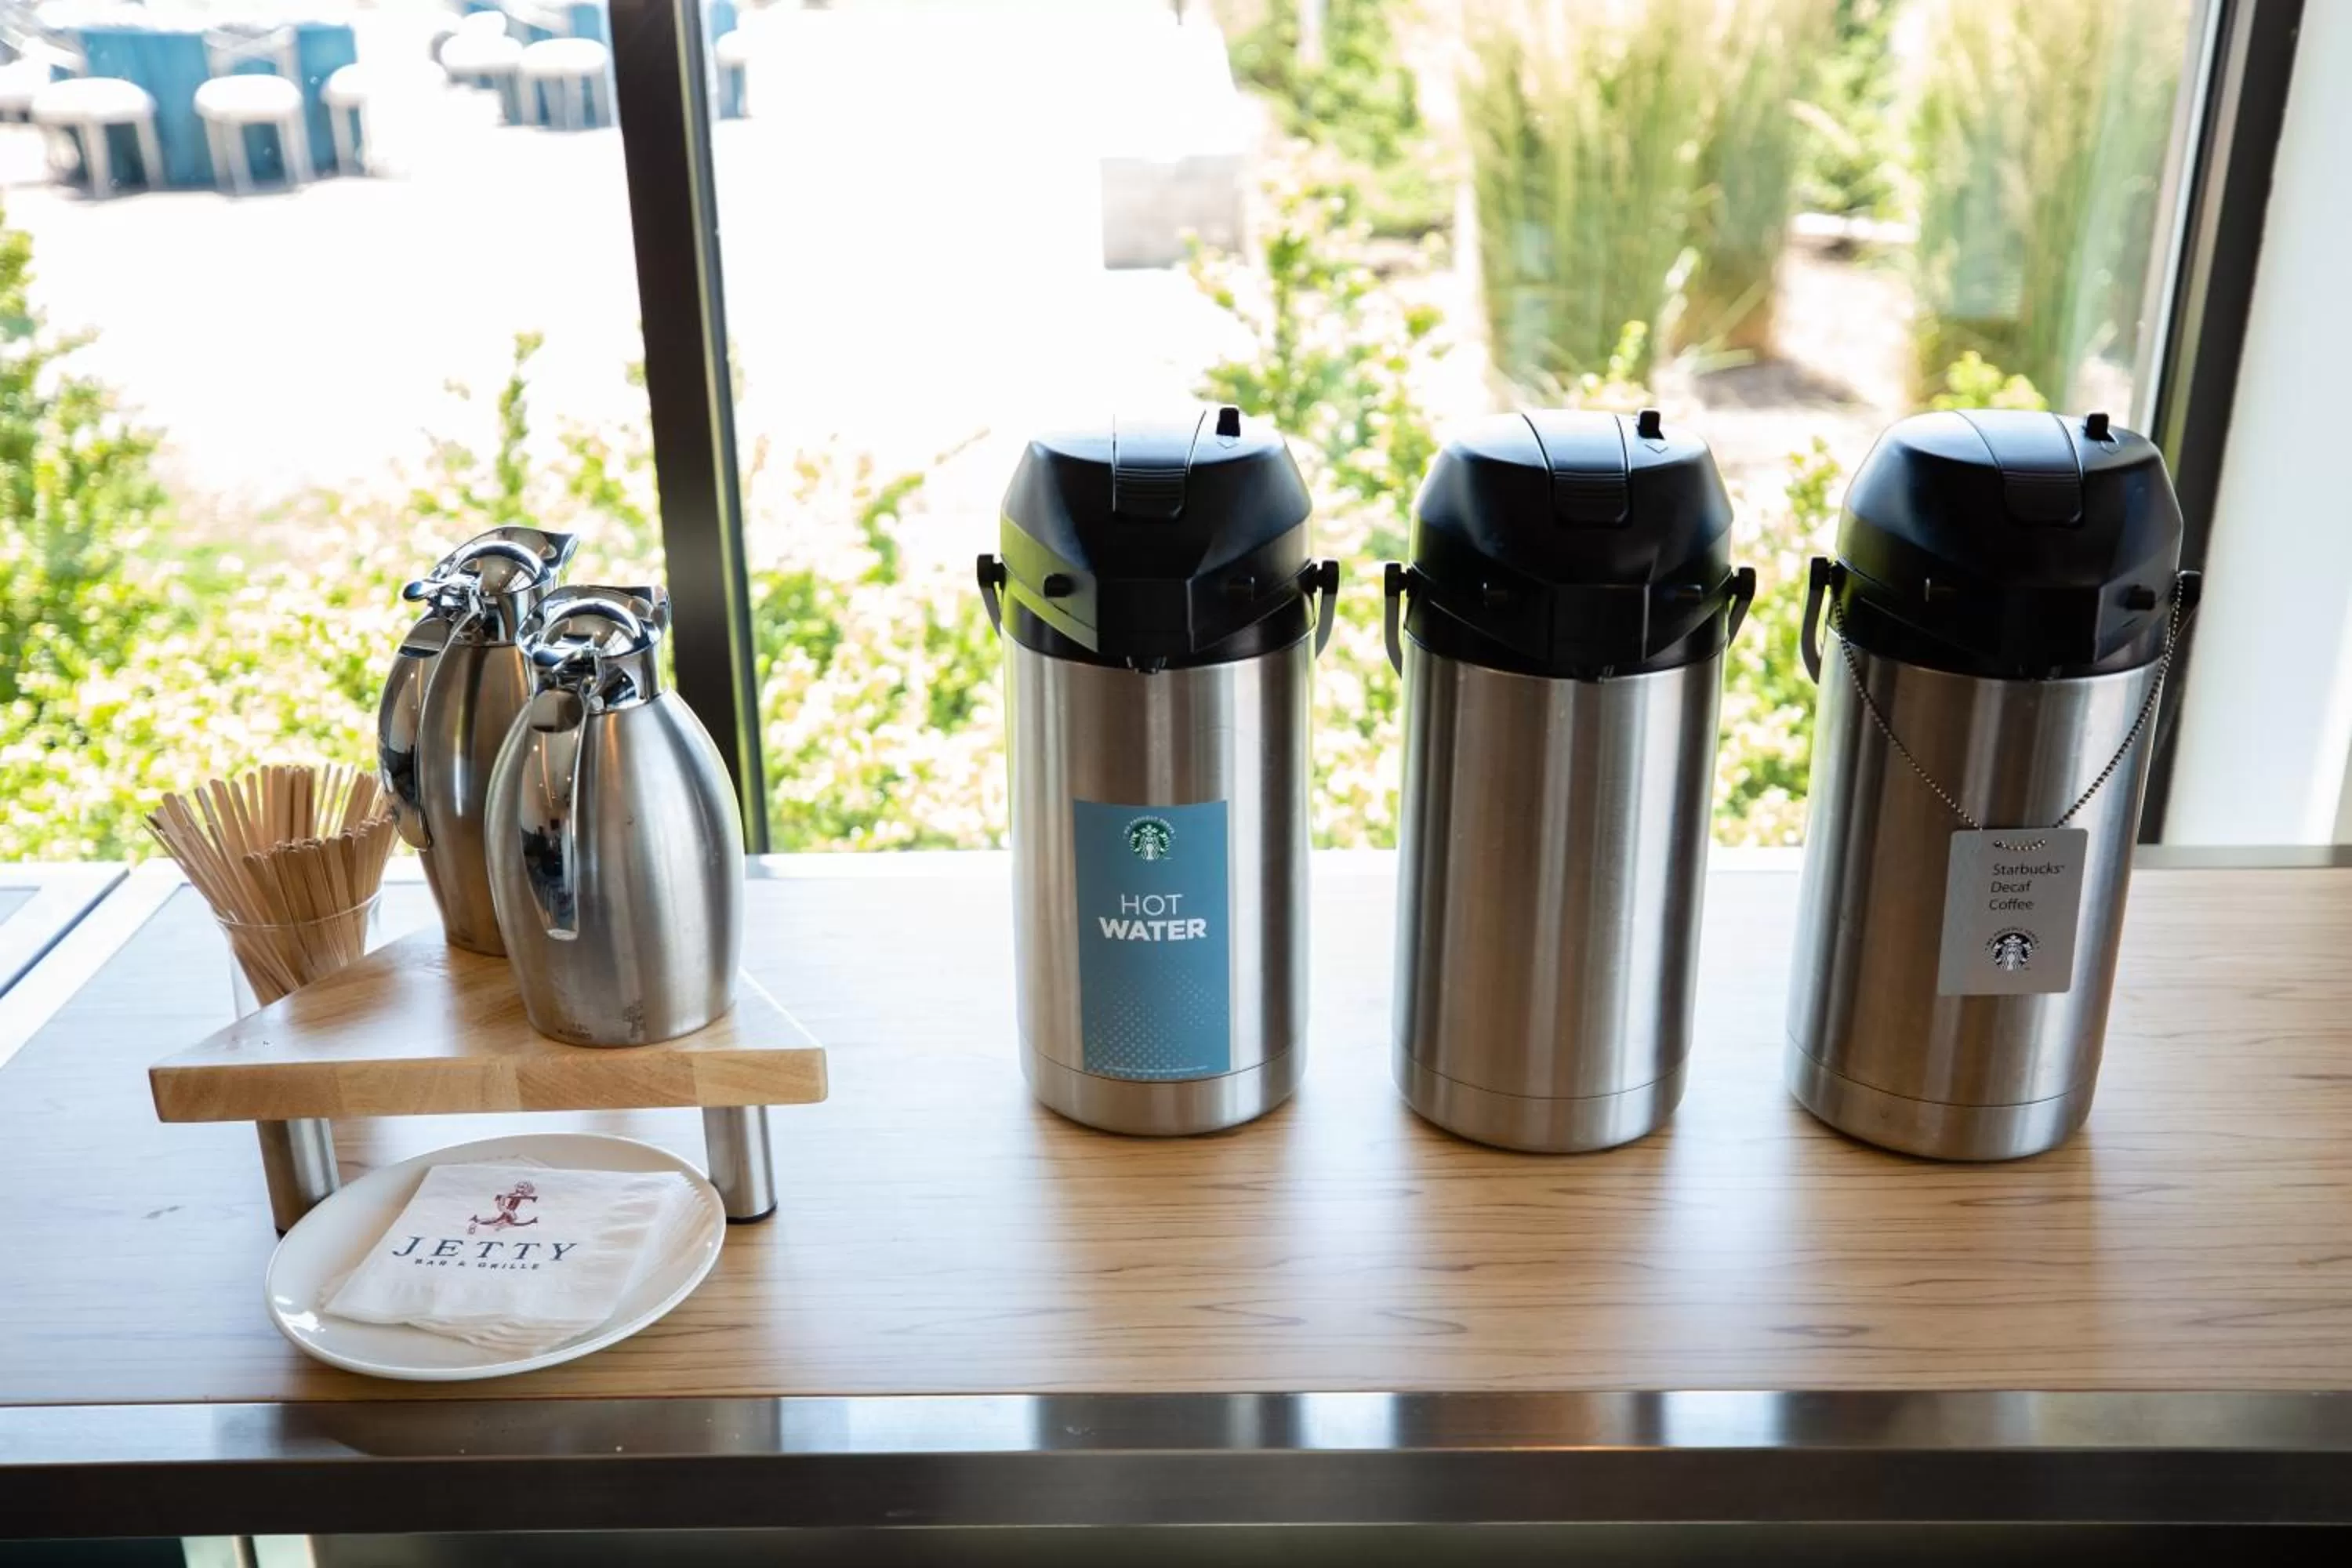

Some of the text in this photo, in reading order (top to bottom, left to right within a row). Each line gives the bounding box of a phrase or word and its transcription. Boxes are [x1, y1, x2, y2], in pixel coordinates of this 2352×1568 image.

[1991, 880, 2032, 893] Decaf
[1120, 894, 1184, 916] HOT
[1989, 898, 2034, 910] Coffee
[1098, 916, 1207, 941] WATER
[391, 1236, 578, 1261] JETTY
